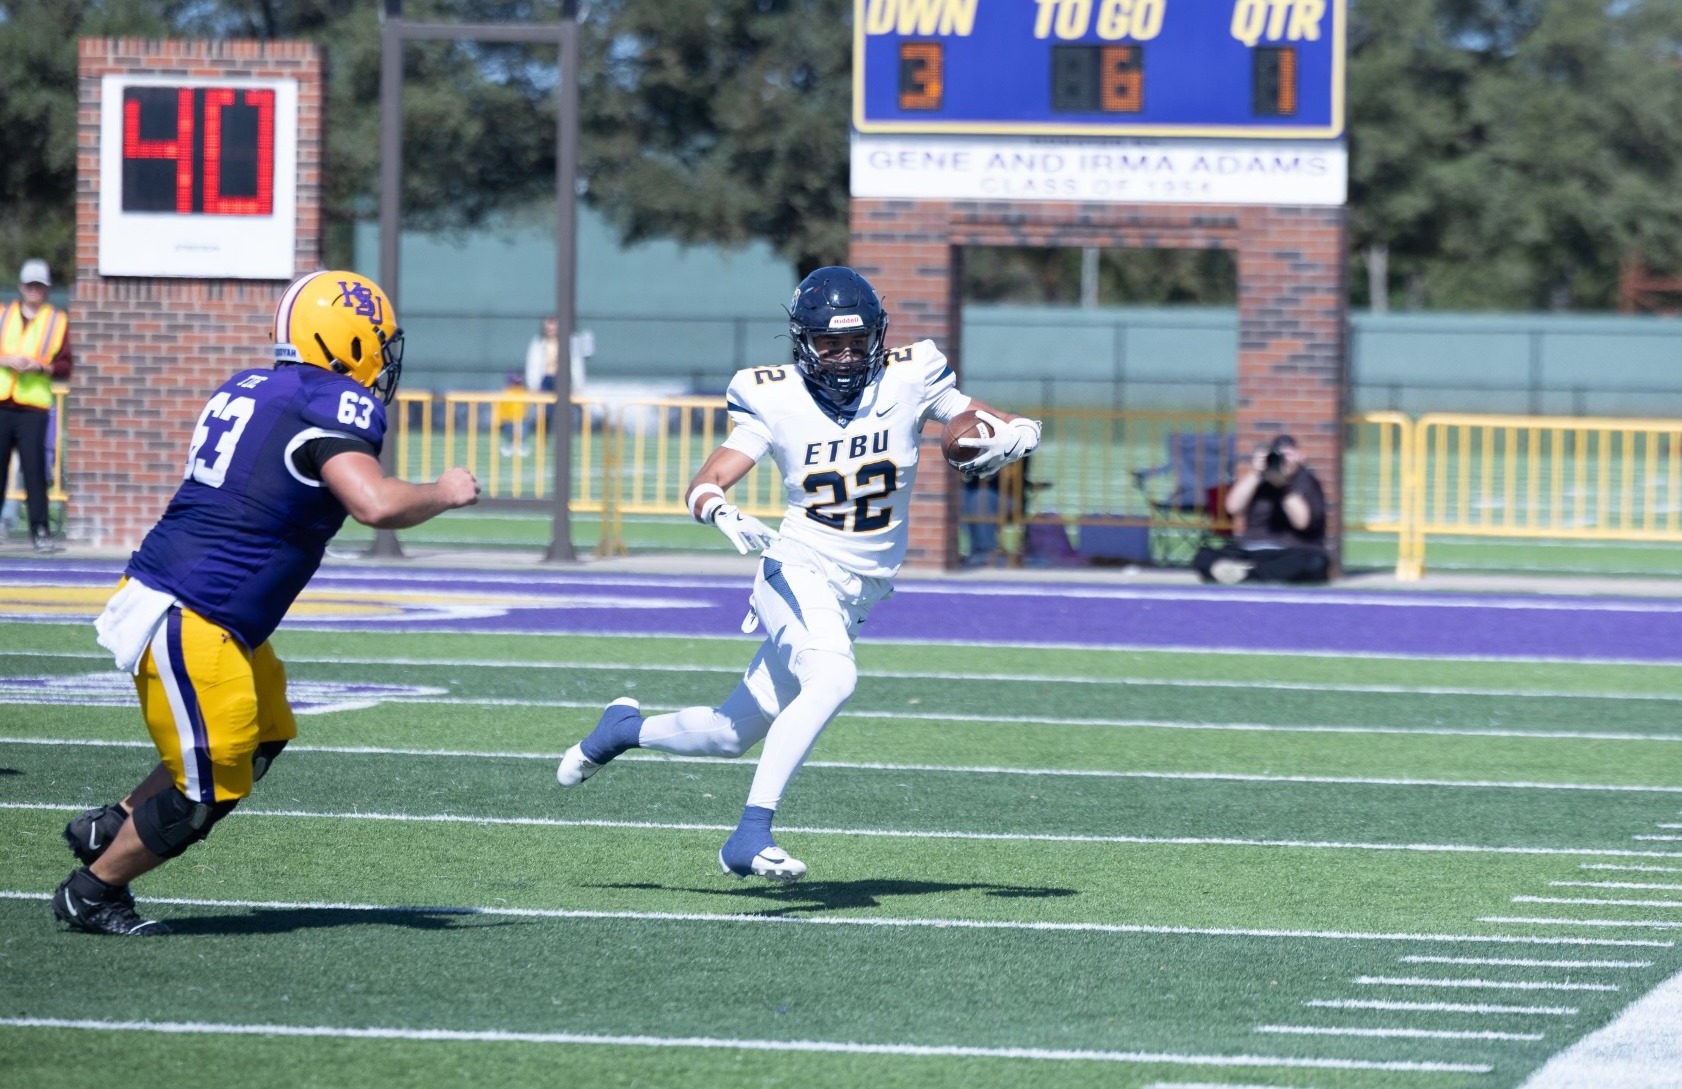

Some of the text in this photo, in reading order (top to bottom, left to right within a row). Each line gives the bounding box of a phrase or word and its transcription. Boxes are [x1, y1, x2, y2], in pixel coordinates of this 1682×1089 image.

[866, 0, 979, 36] DWN
[1034, 0, 1166, 40] TO GO
[1230, 0, 1326, 47] QTR
[900, 43, 942, 110] 3
[1101, 45, 1144, 112] 6
[1278, 48, 1296, 115] 1
[124, 87, 275, 215] 40
[869, 150, 1328, 176] GENE AND IRMA ADAMS
[980, 177, 1078, 194] CLASS
[1092, 178, 1129, 195] OF
[337, 391, 375, 430] 63
[184, 392, 256, 488] 63
[804, 429, 890, 466] ETBU
[802, 458, 898, 533] 22
